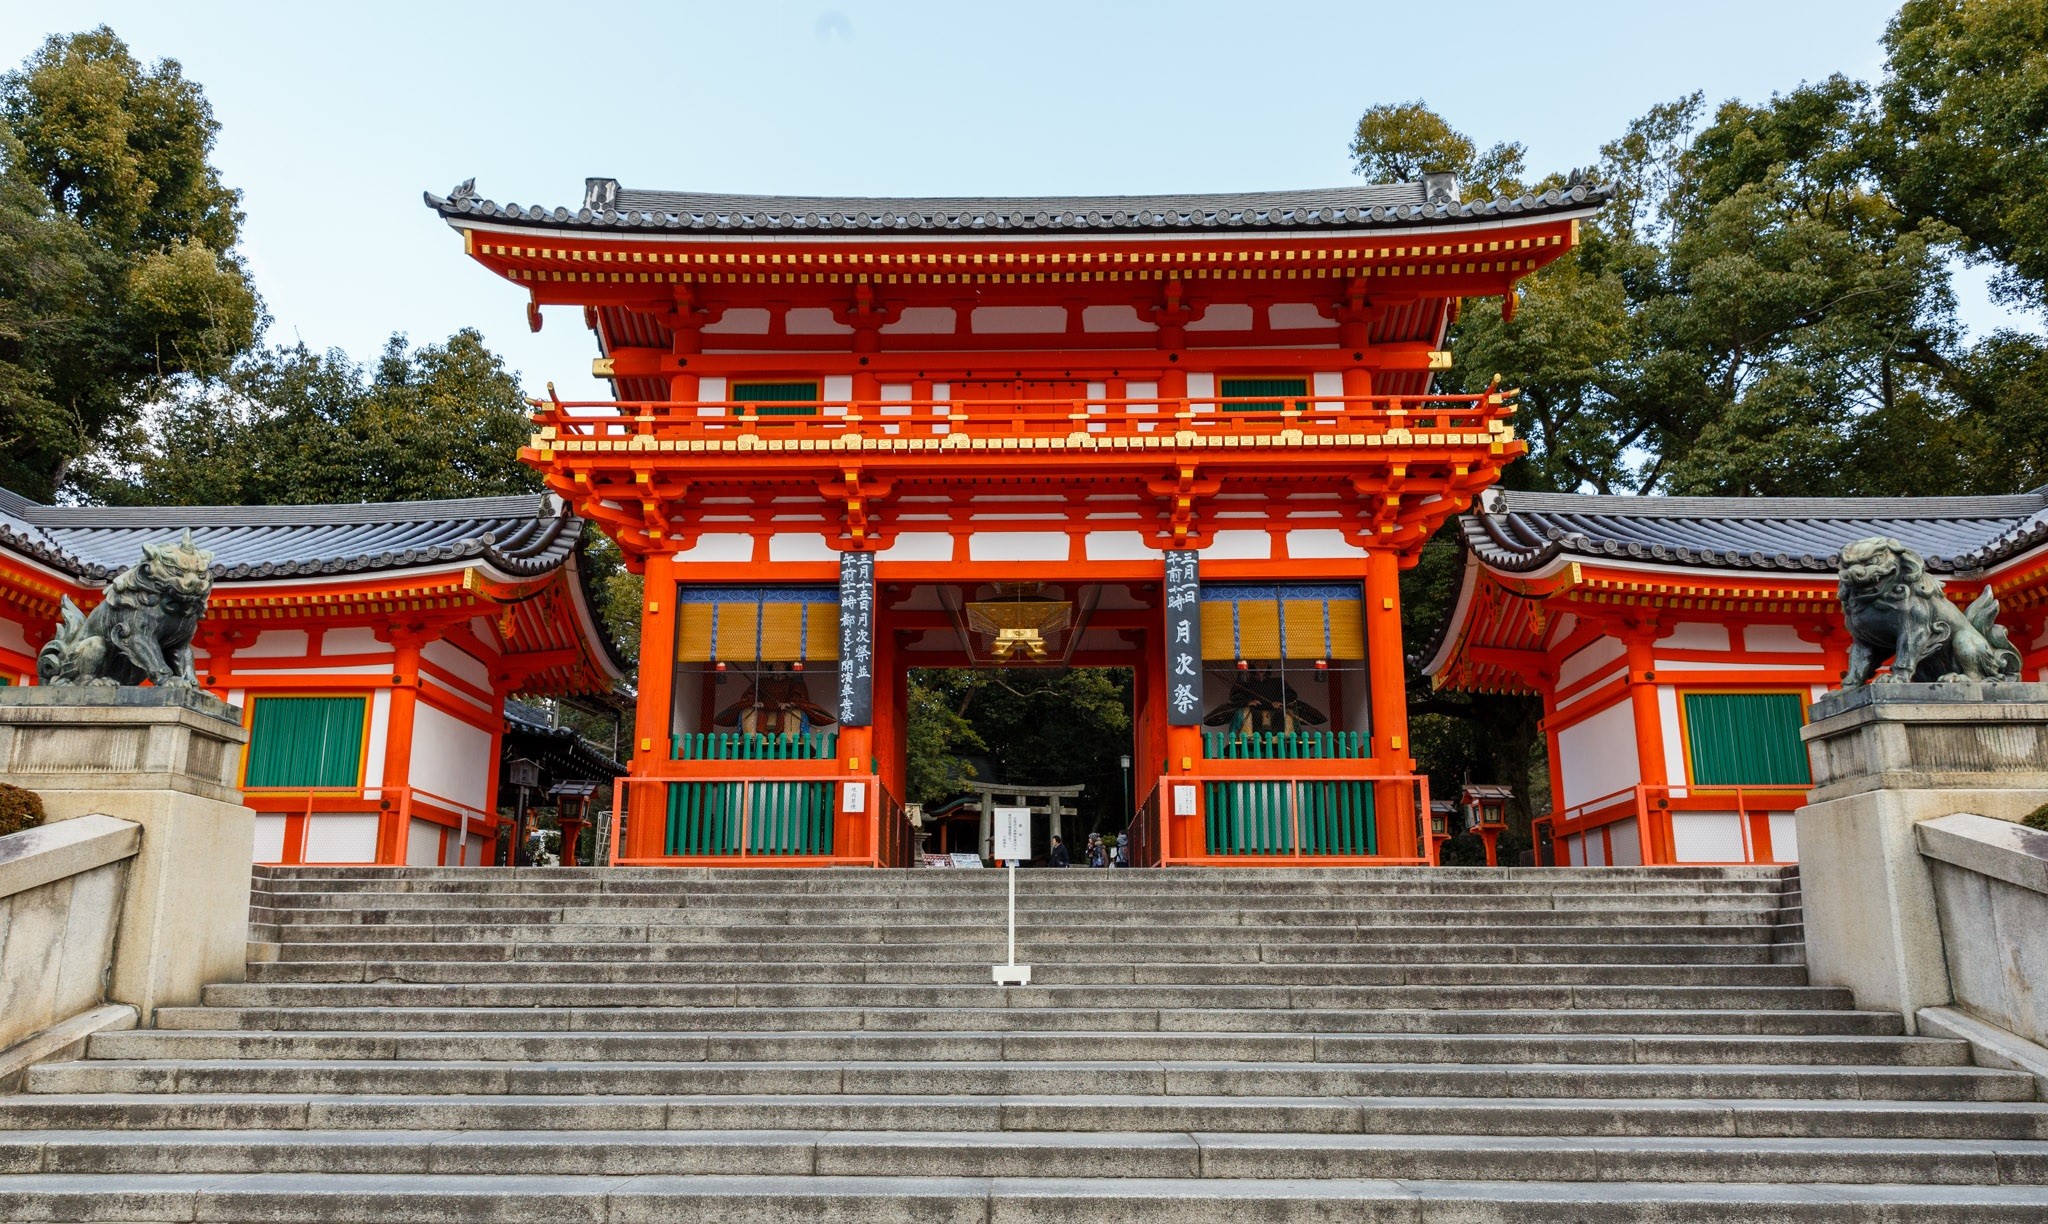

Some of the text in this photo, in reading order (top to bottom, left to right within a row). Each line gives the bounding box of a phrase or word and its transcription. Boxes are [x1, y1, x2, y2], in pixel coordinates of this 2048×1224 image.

[1166, 552, 1186, 612] 午前十時
[1180, 553, 1198, 604] 三月一日
[1173, 619, 1199, 715] 月次祭
